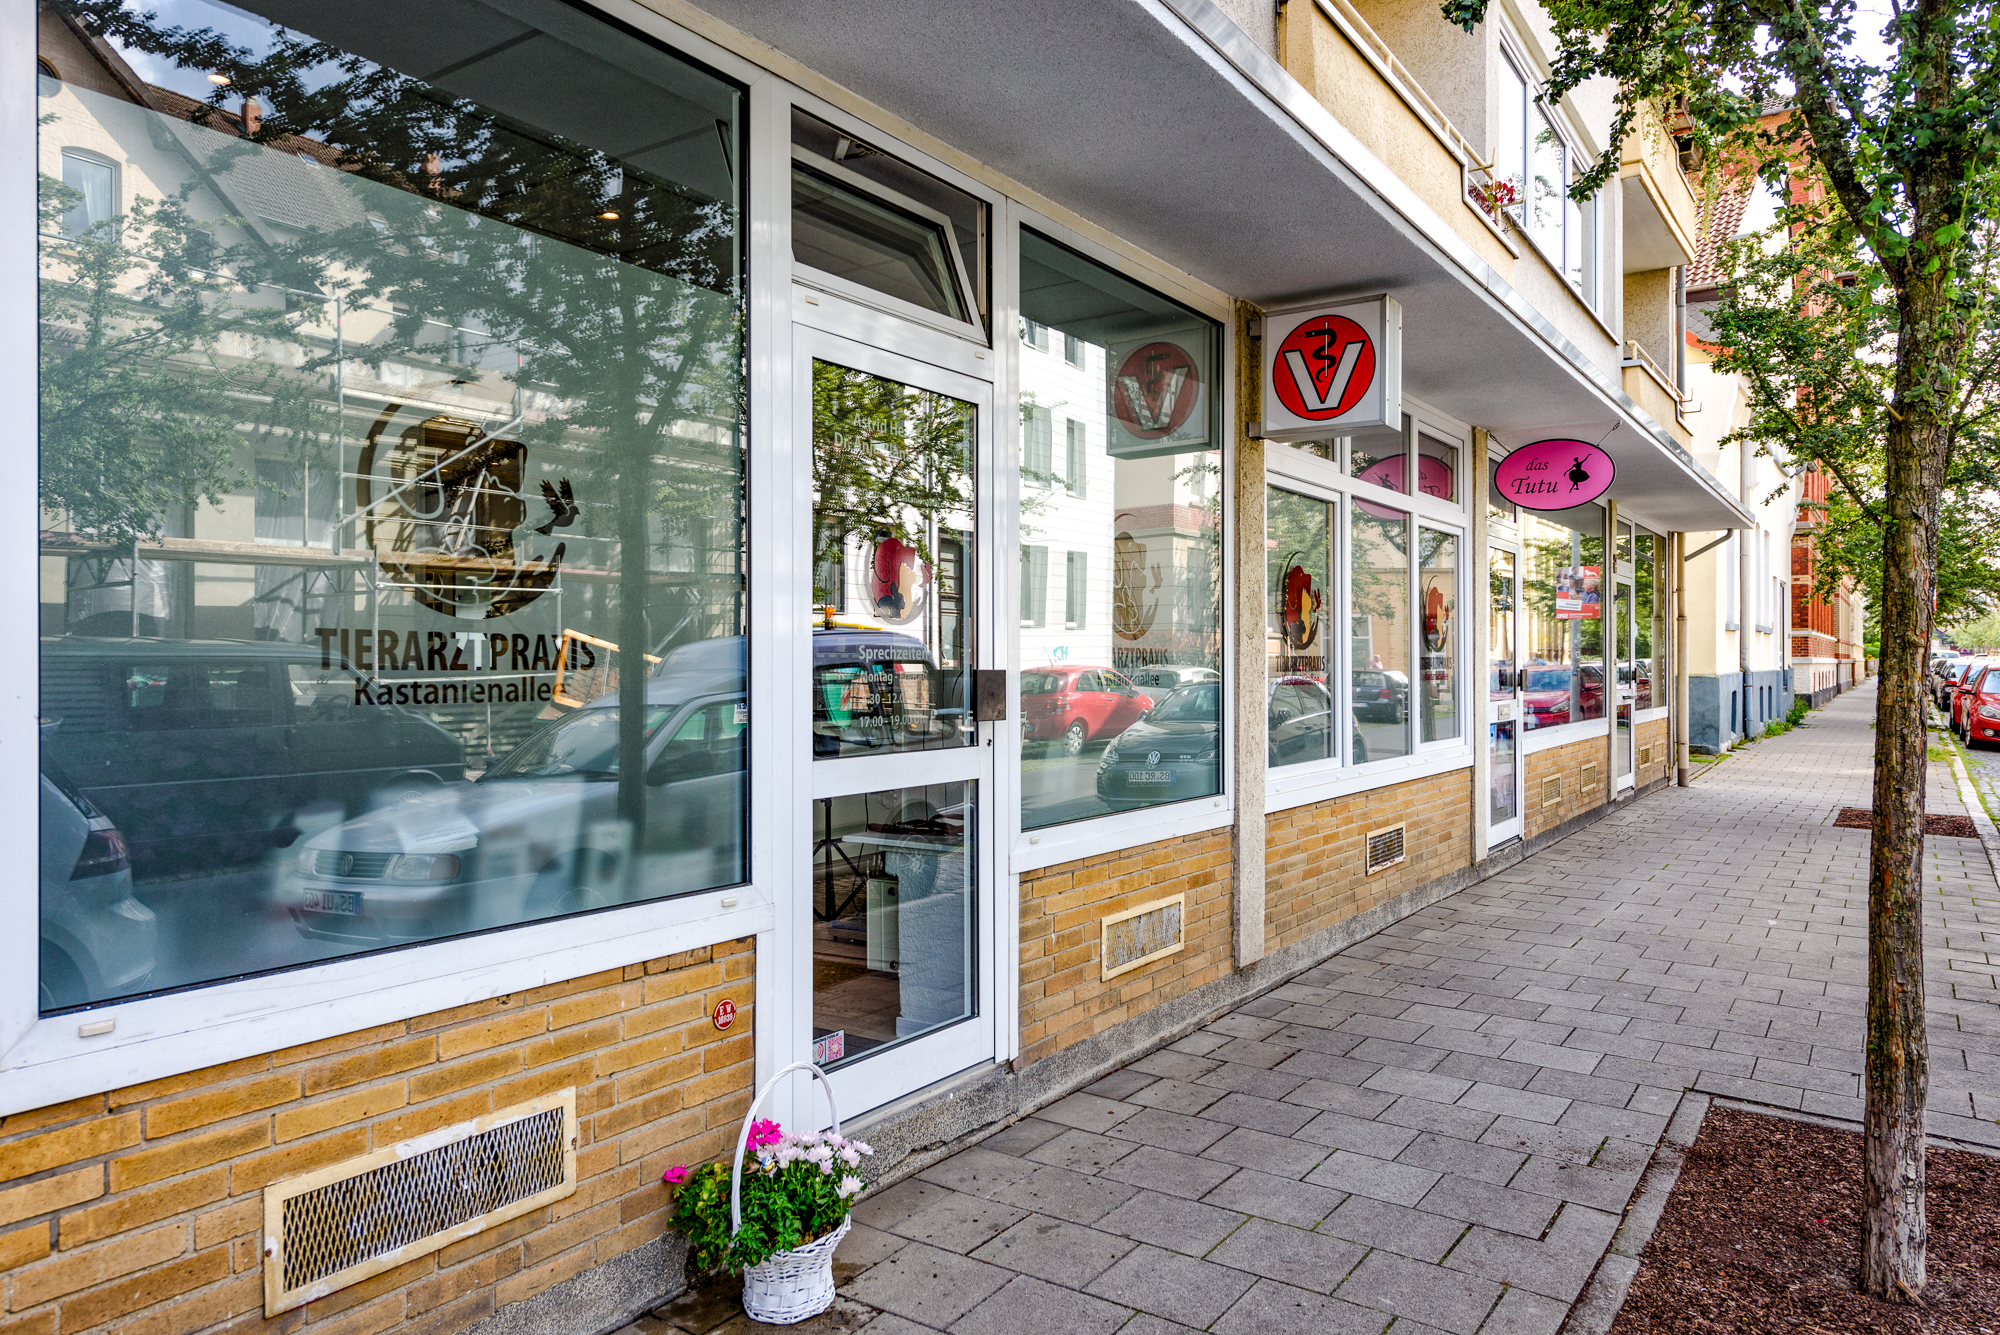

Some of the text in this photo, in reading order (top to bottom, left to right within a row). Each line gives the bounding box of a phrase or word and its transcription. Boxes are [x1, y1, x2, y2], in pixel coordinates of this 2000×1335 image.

[853, 413, 887, 434] Astrid
[1525, 457, 1550, 471] das
[1511, 475, 1558, 495] Tutu
[314, 627, 596, 671] TIERARZTPRAXIS
[858, 644, 929, 664] Sprechzeiten
[860, 670, 893, 685] Montag
[354, 675, 567, 706] Kastanienallee
[860, 715, 883, 728] 17.00
[719, 1003, 732, 1016] E W
